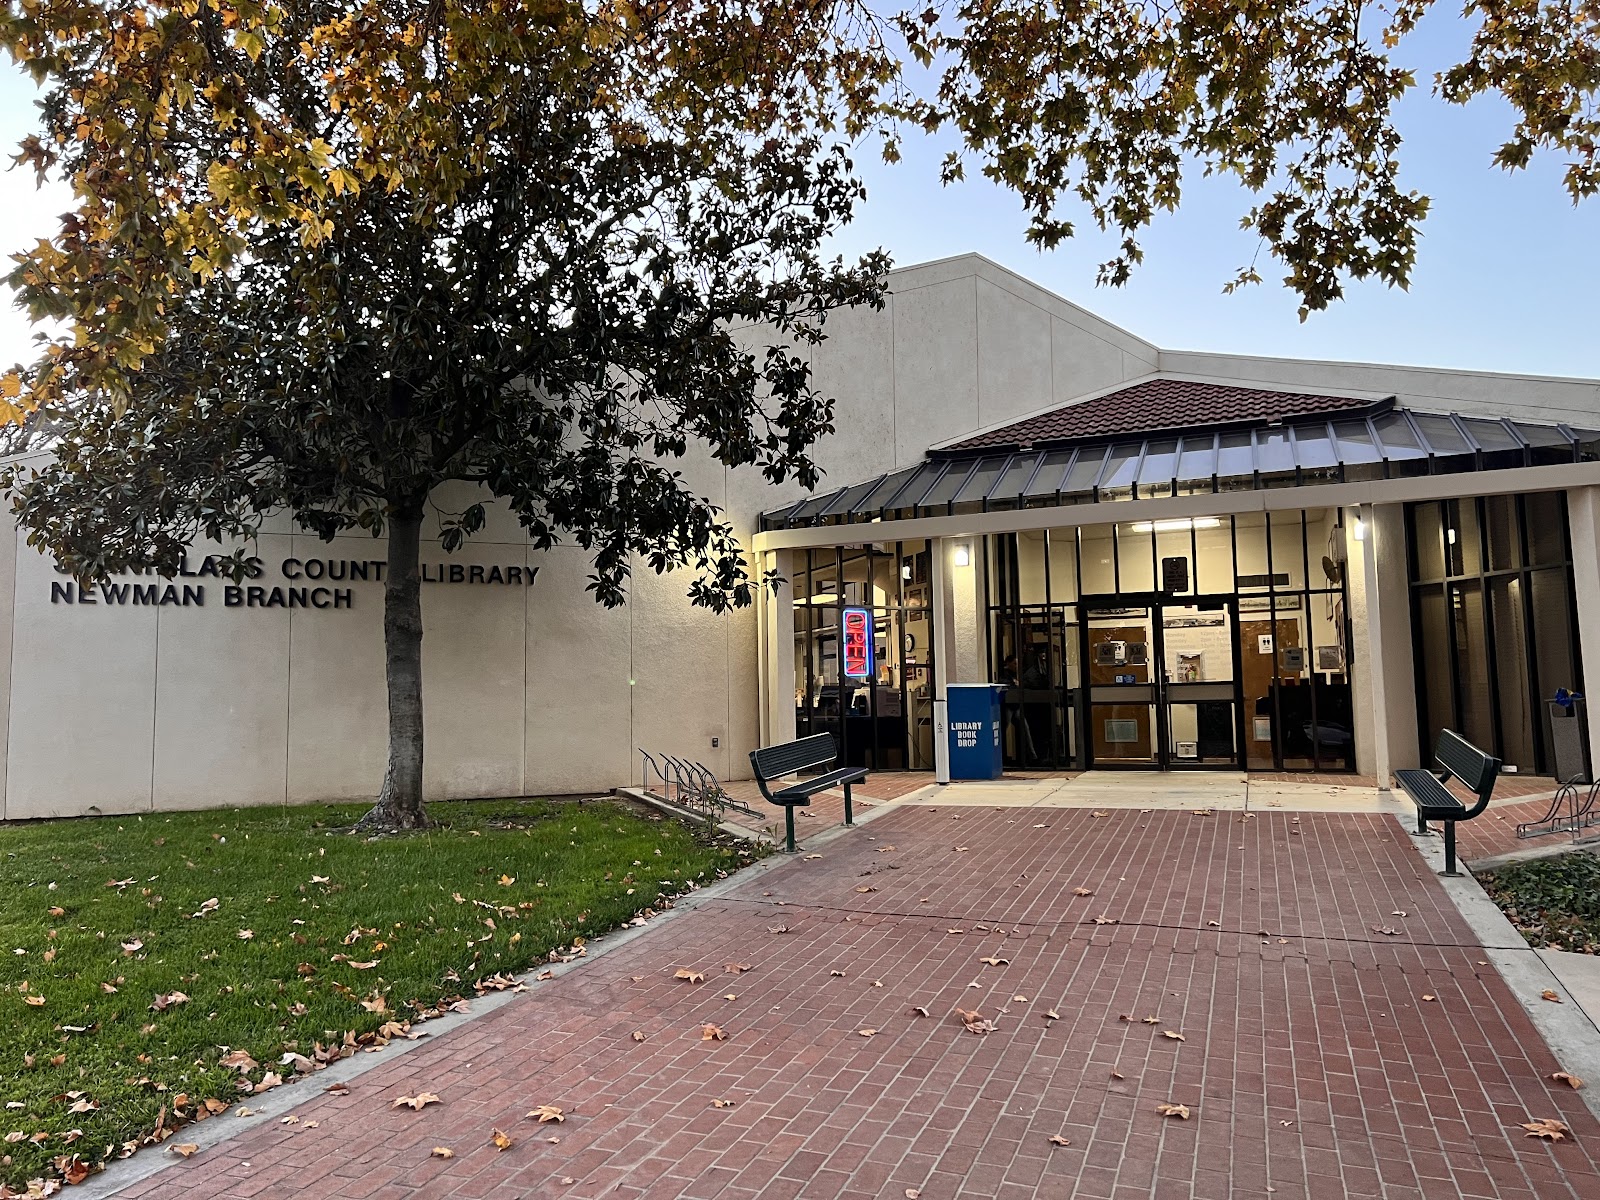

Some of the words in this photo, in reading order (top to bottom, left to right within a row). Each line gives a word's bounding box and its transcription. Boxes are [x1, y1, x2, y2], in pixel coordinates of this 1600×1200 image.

[281, 557, 388, 581] COUNT
[421, 563, 540, 585] LIBRARY
[51, 581, 204, 606] NEWMAN
[225, 585, 352, 609] BRANCH
[845, 613, 866, 674] OPEN
[951, 722, 982, 730] LIBRARY
[957, 730, 977, 739] BOOK
[957, 739, 977, 747] DROP
